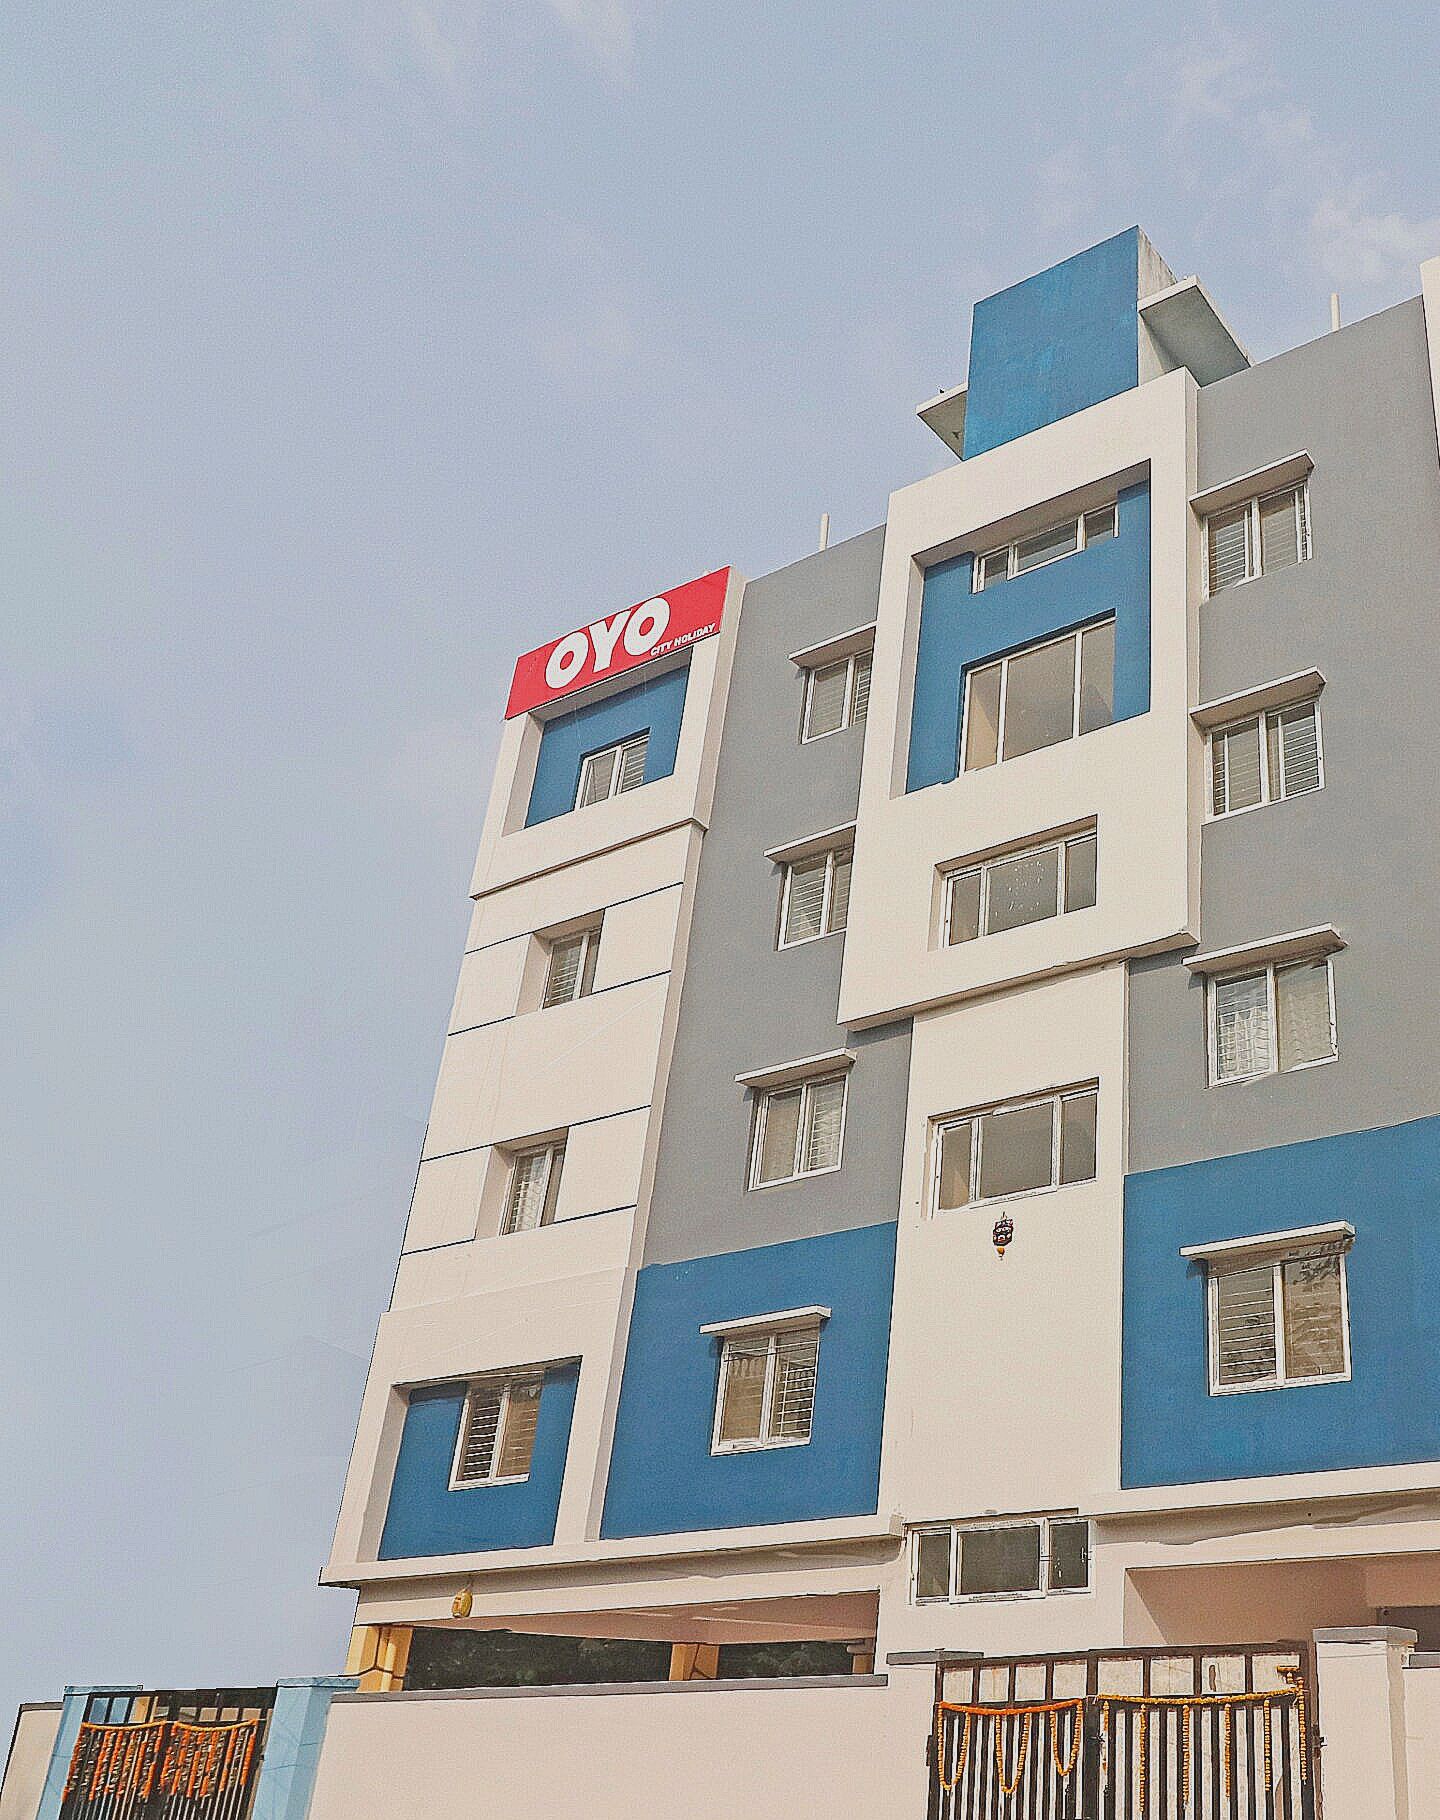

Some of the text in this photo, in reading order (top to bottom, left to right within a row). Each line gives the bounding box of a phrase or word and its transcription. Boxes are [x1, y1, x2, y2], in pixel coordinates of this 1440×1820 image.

[545, 597, 671, 689] OYO
[650, 622, 716, 656] CITY HOLIDAY
